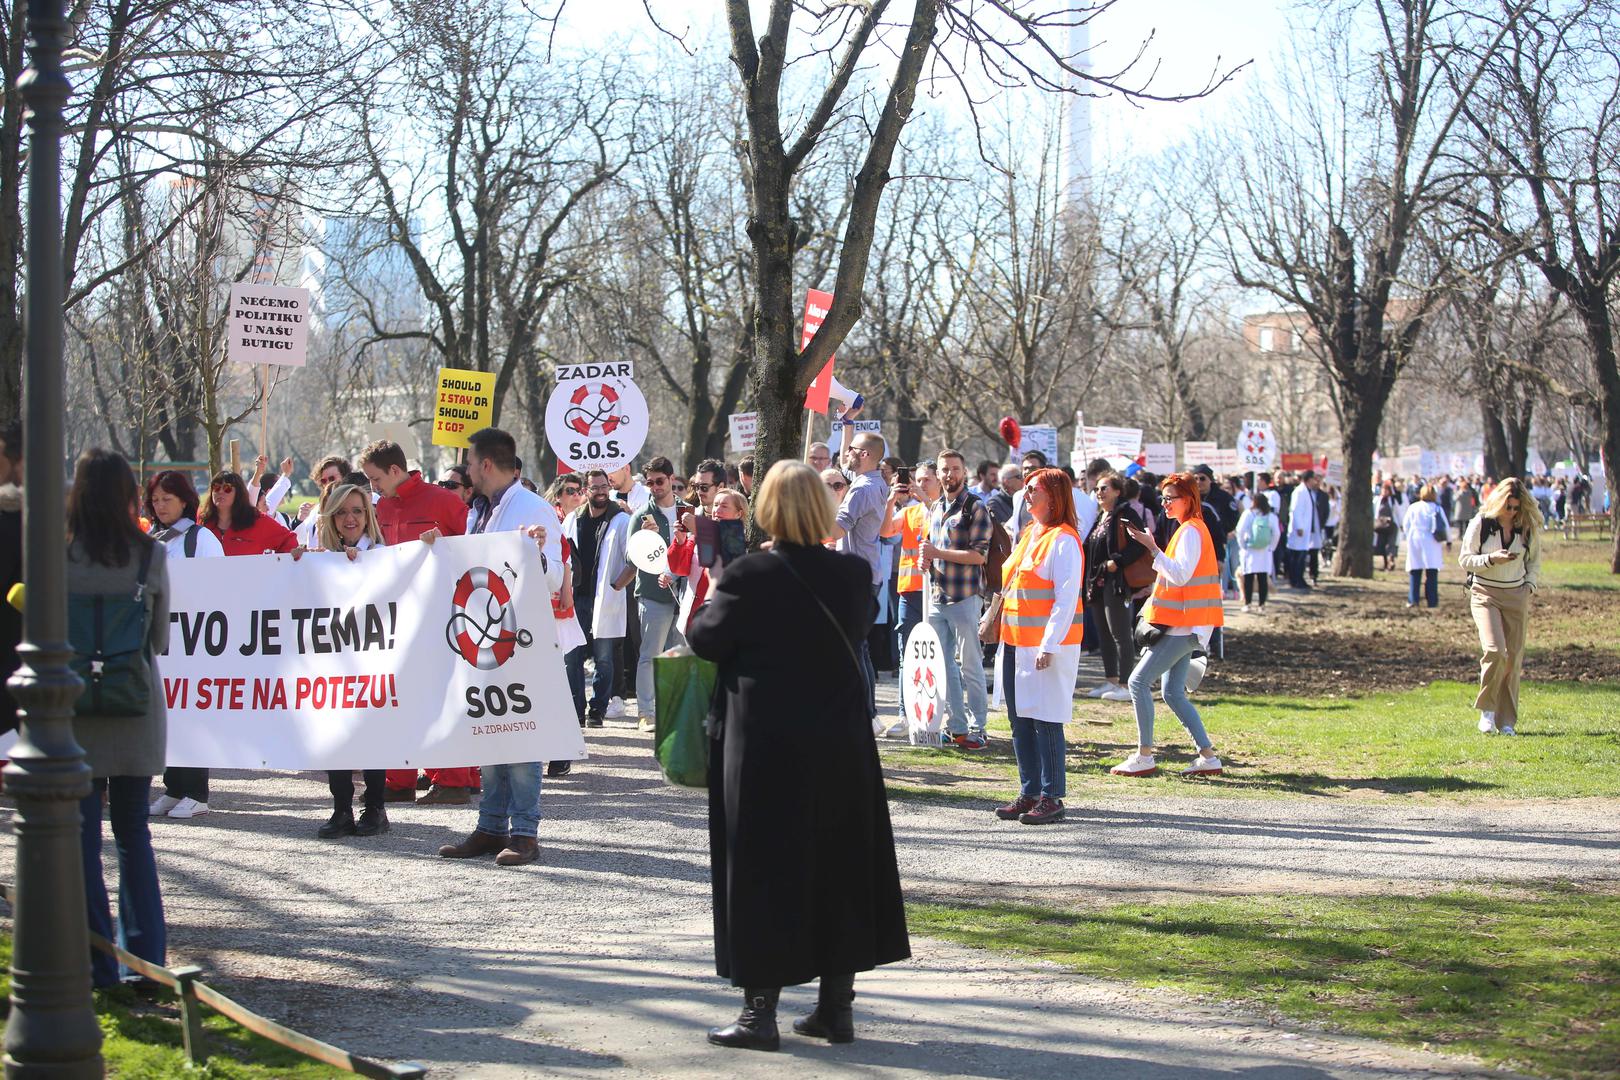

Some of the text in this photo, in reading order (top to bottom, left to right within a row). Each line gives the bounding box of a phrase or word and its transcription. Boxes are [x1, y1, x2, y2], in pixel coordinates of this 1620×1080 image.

[240, 296, 299, 309] NEĆEMO
[235, 309, 303, 323] POLITIKU
[243, 324, 293, 336] U NAŠU
[241, 338, 294, 350] BUTIGU
[557, 363, 631, 381] ZADAR
[441, 379, 482, 392] SHOULD
[440, 393, 488, 407] I STAY OR
[439, 407, 479, 420] SHOULD
[437, 421, 465, 433] I GO?
[832, 422, 880, 432] CRENICA
[569, 440, 626, 460] S.O.S.
[646, 545, 665, 562] SOS
[239, 609, 282, 656] JE
[291, 602, 397, 655] TEMA!
[164, 674, 399, 710] VI STE NA POTEZU!
[465, 683, 532, 718] SOS
[472, 721, 537, 736] ZA ZDRAVSTVO
